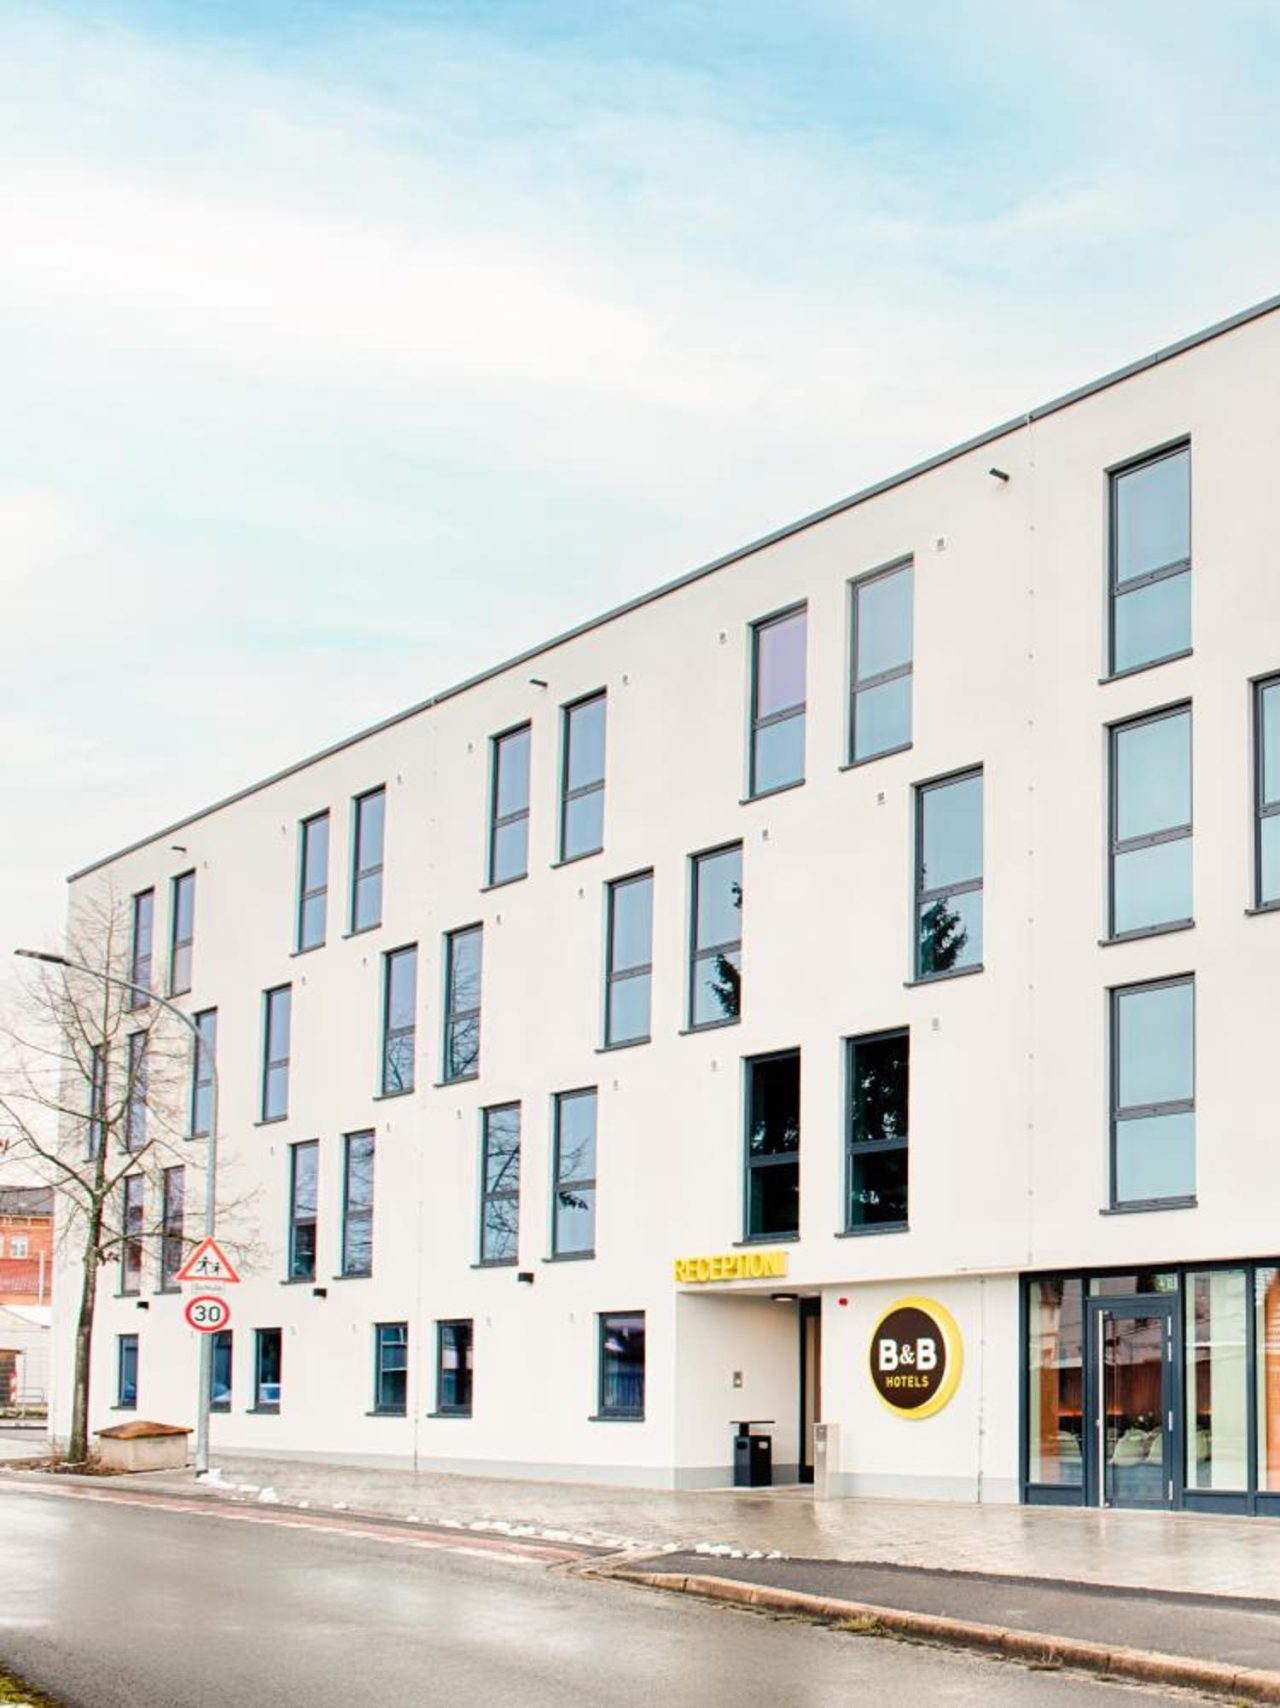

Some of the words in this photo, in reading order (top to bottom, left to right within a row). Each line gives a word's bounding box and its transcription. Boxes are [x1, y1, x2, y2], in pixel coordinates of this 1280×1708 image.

[673, 1251, 788, 1283] RECEPTION
[194, 1304, 220, 1322] 30
[878, 1338, 937, 1370] B&B
[885, 1376, 929, 1388] HOTELS
